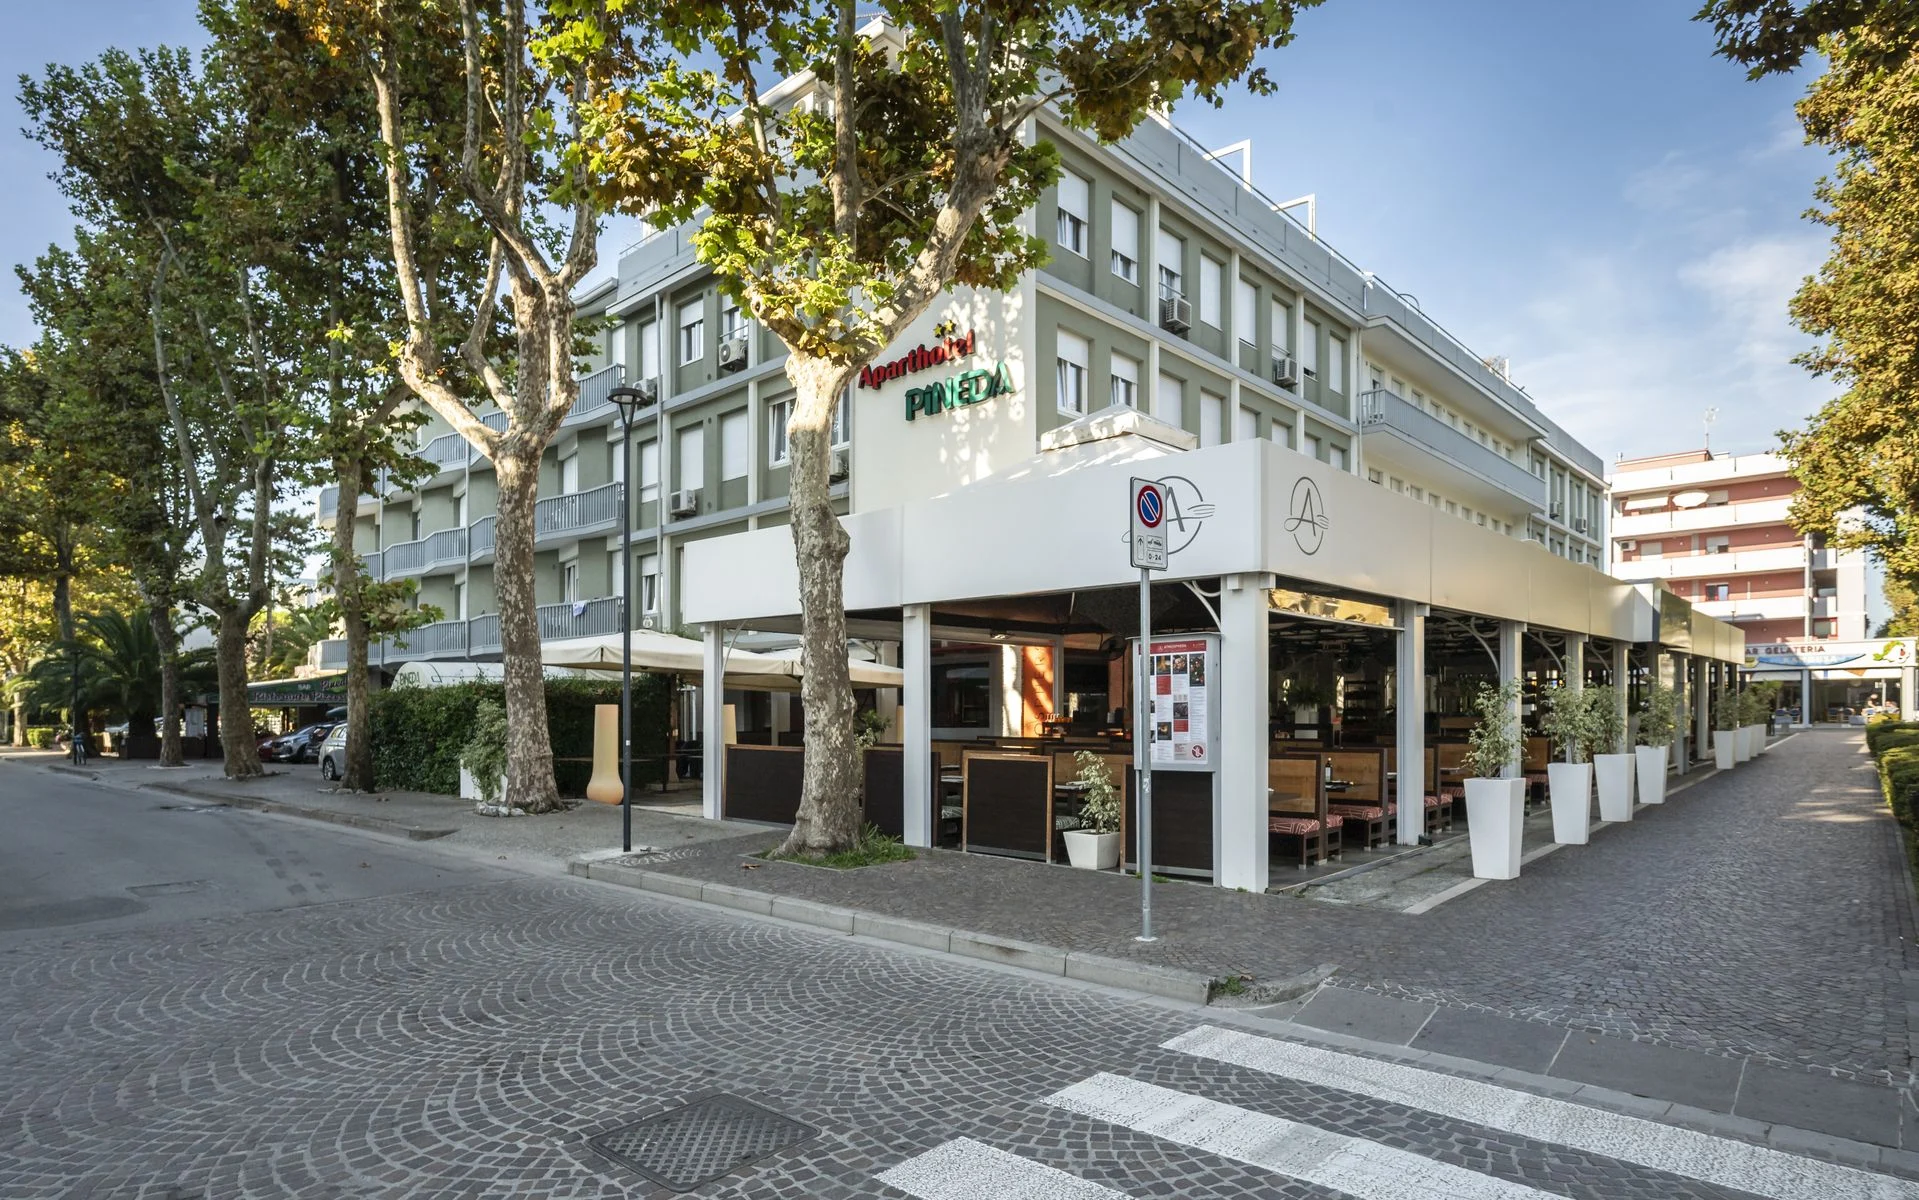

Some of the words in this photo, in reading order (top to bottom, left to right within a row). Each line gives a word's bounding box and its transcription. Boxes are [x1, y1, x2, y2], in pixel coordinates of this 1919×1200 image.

[857, 328, 976, 390] Aparthotel
[1745, 647, 1759, 655] AR
[1765, 646, 1826, 655] GELATERIA
